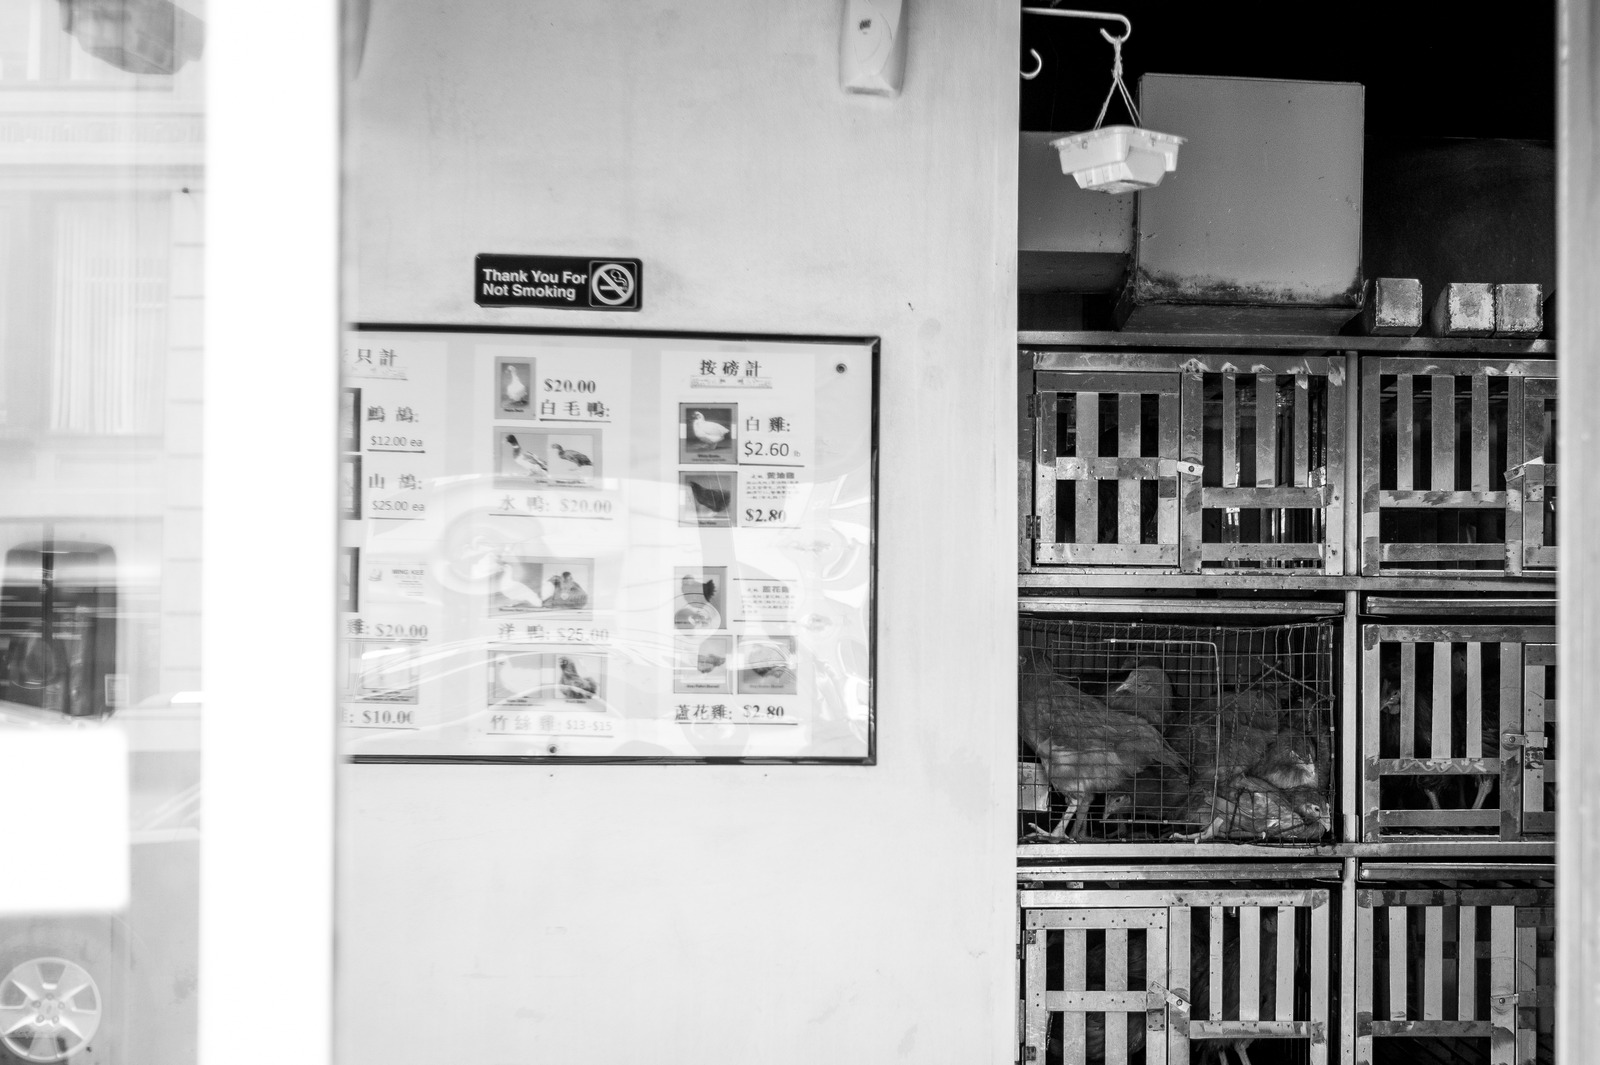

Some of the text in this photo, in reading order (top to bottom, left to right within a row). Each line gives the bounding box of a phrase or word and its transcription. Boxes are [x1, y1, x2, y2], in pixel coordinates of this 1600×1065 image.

[482, 268, 588, 285] Thank You For
[482, 283, 576, 301] Not Smoking
[700, 359, 762, 377] 按磅計
[543, 378, 596, 394] $20.00
[541, 399, 610, 418] 白毛鴨:
[370, 436, 424, 447] $12.00 ea
[744, 441, 790, 457] $2.60
[372, 500, 425, 512] $25.00 ea
[560, 499, 612, 514] $20.00
[745, 508, 787, 522] $2.80
[375, 624, 429, 637] $20.00
[557, 627, 609, 642] $25.00
[362, 710, 416, 724] $10.00
[743, 705, 785, 719] $2.80
